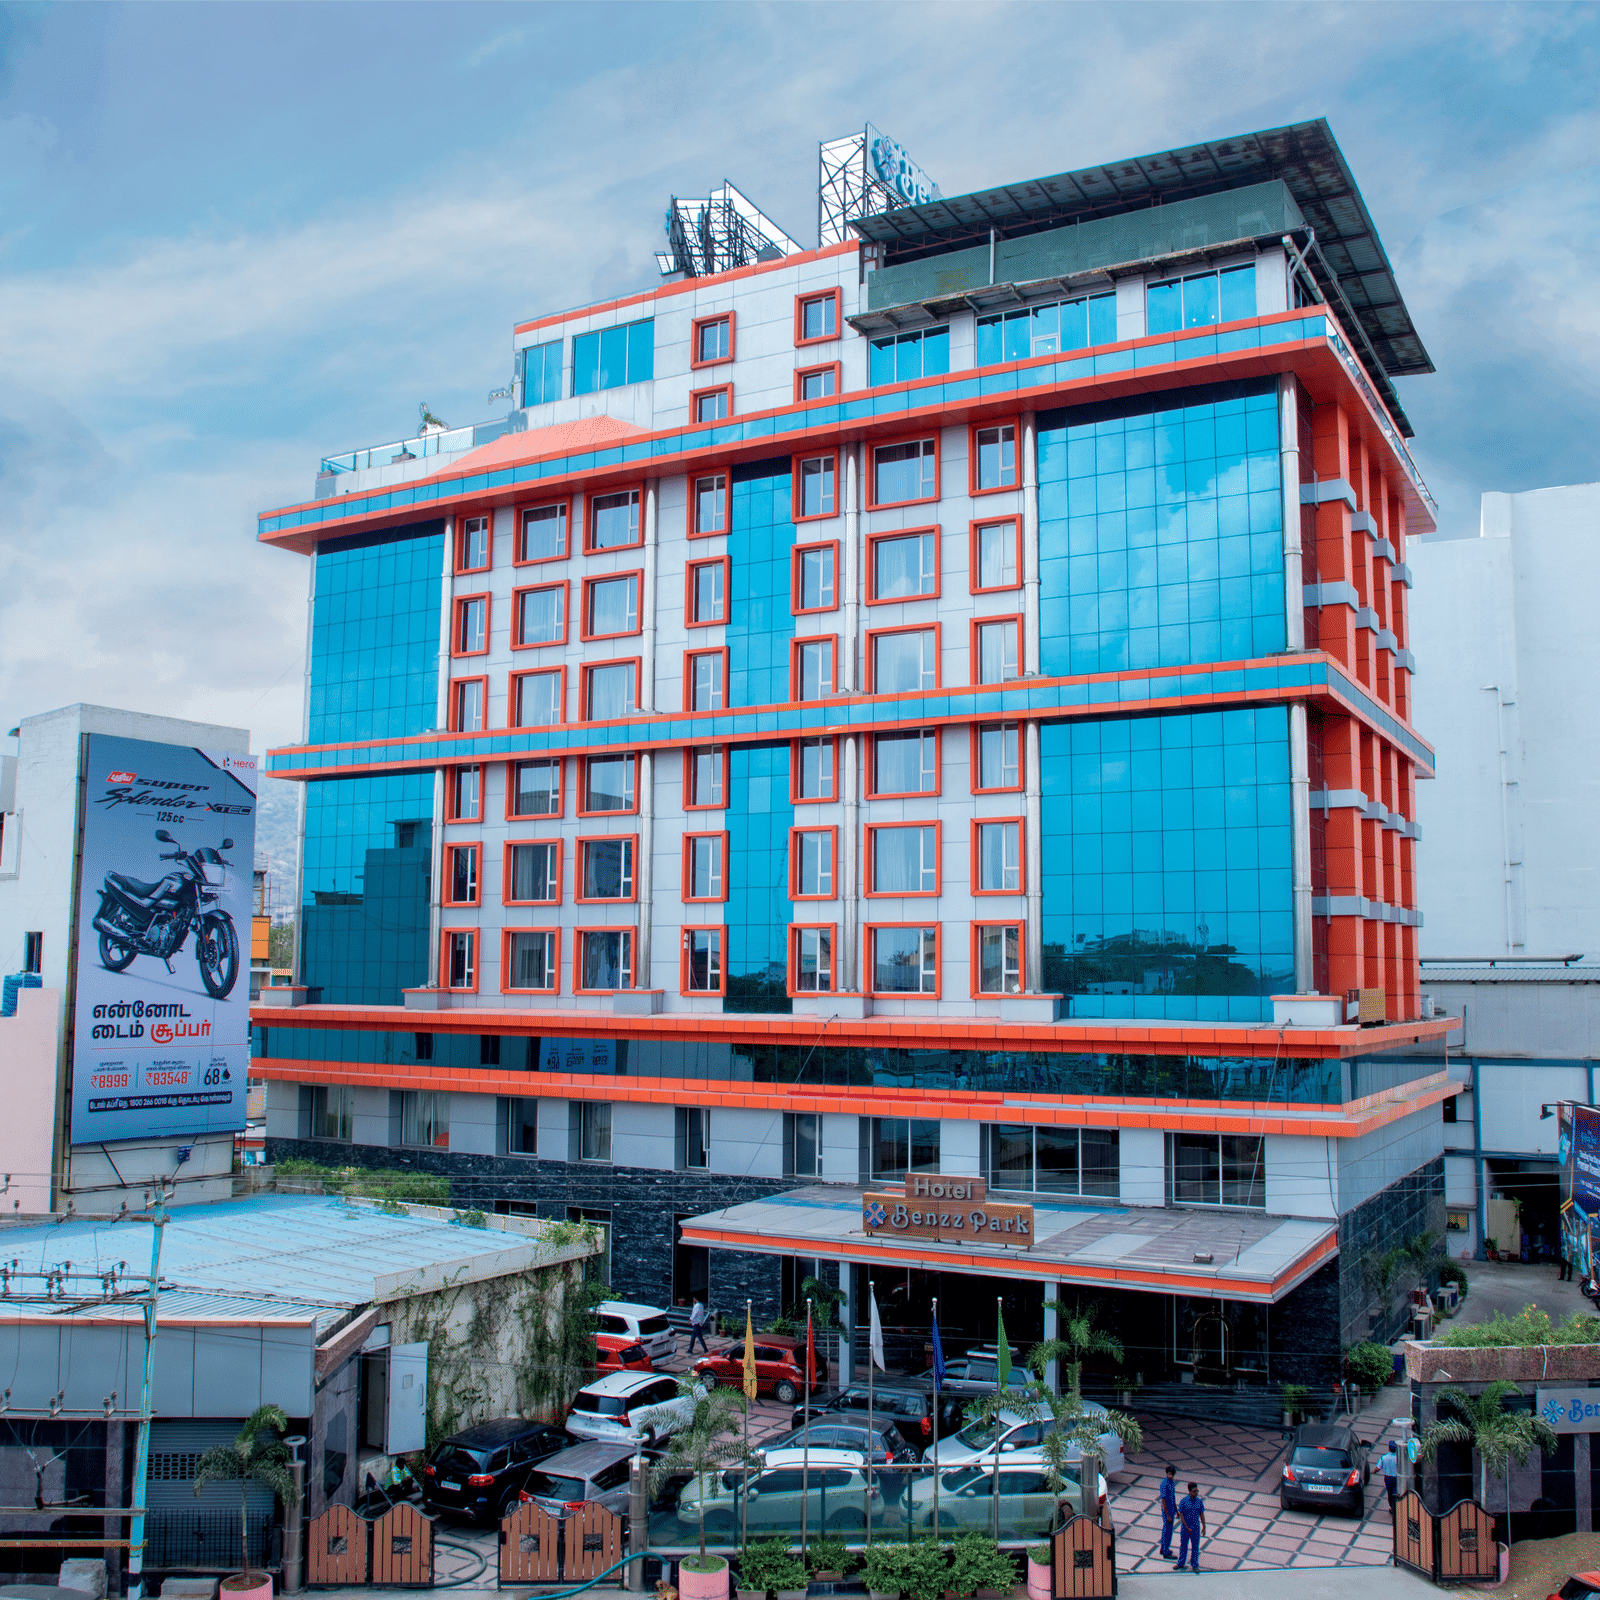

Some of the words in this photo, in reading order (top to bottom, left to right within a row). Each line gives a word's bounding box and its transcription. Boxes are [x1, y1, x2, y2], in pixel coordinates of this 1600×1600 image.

[94, 787, 206, 810] Splendor
[203, 802, 253, 816] XTEC
[92, 999, 191, 1019] என்னோட
[92, 1019, 145, 1039] டைம்
[150, 1019, 212, 1044] சூப்பர்
[204, 1068, 220, 1085] 68
[914, 1177, 972, 1200] Hotel
[890, 1204, 964, 1229] Benzz
[968, 1209, 1029, 1234] Park
